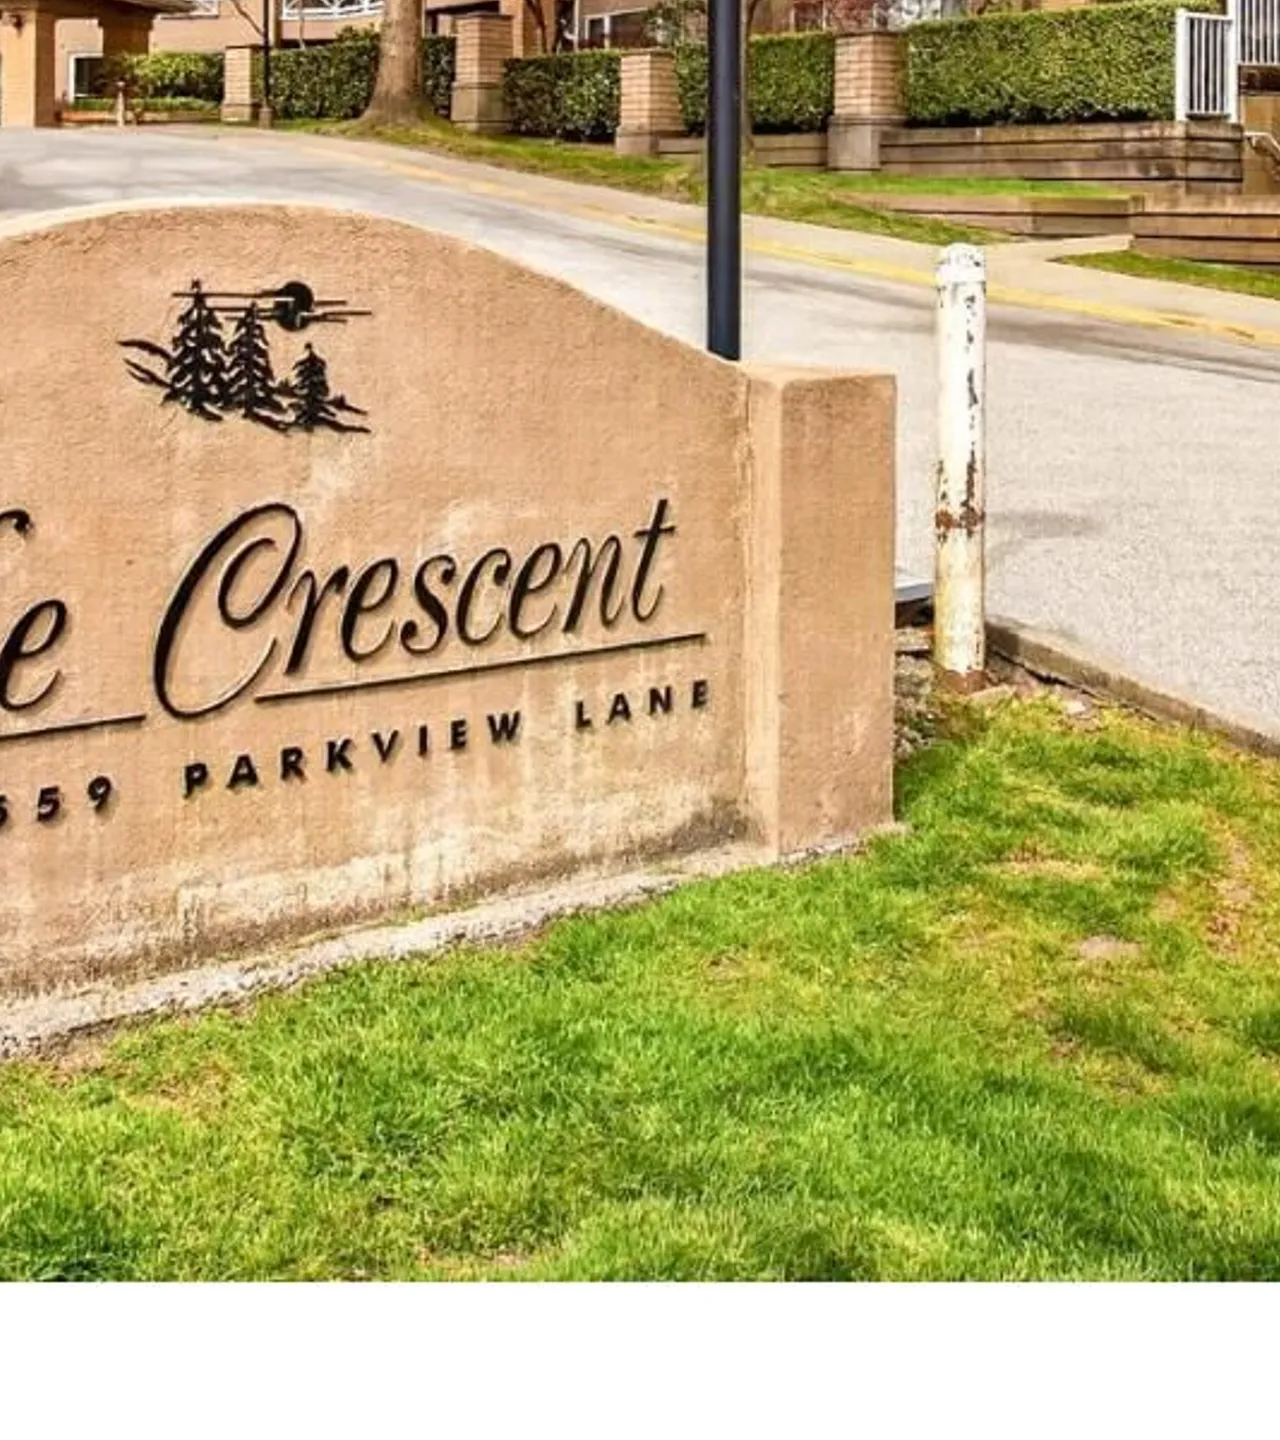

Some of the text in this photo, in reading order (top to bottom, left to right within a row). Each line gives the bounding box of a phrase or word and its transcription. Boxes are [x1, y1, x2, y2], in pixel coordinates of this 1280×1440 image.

[153, 498, 676, 720] Crescent
[182, 710, 521, 798] PARKVIEW
[574, 679, 710, 730] LANE
